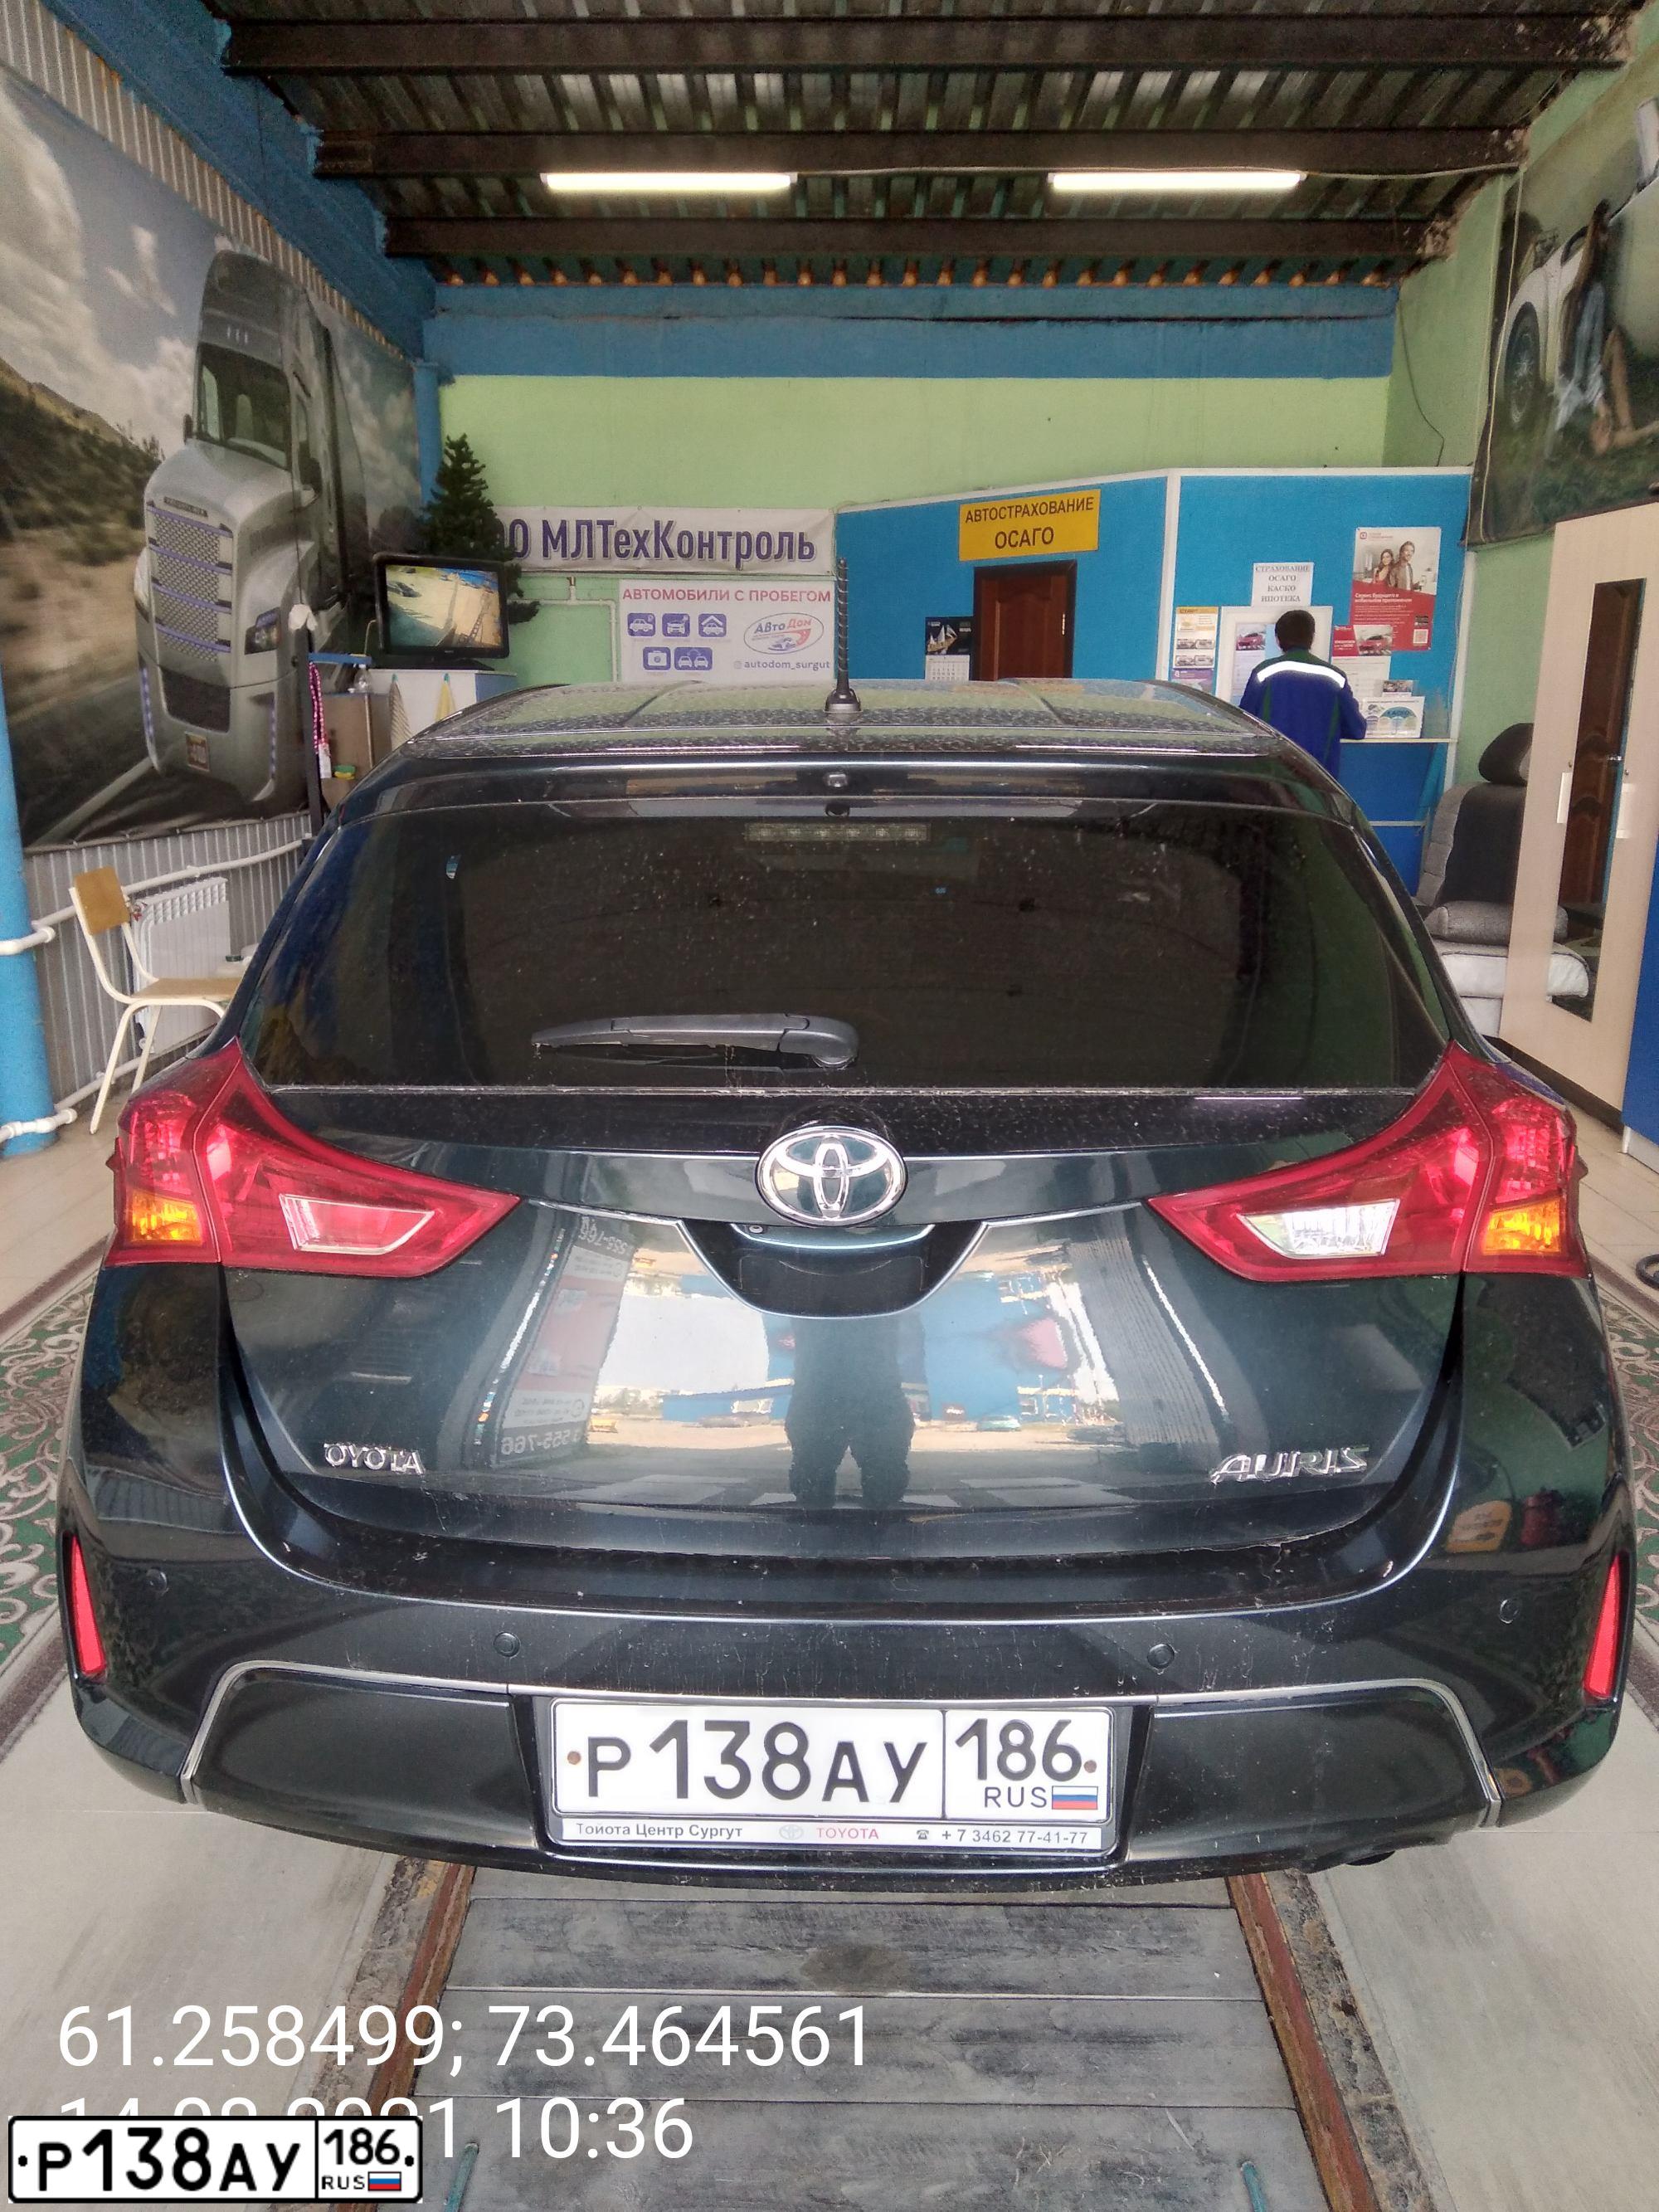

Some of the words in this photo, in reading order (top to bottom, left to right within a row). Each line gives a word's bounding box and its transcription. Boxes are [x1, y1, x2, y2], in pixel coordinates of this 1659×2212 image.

[965, 497, 1095, 524] АВТОСТРАХОВАНИЕ
[542, 519, 816, 571] МЛТехКонтроль
[995, 526, 1054, 549] ОСАГО
[622, 588, 730, 602] АВТОМОБИЛИ
[734, 590, 744, 602] С
[749, 590, 831, 602] ПРОБЕГОМ
[1211, 1446, 1369, 1484] AURIS
[587, 1718, 928, 1804] Р138АУ
[955, 1717, 1082, 1782] 186
[984, 1786, 1048, 1809] RUS
[577, 1822, 630, 1835] Тойота
[636, 1824, 684, 1838] Центр
[688, 1825, 743, 1839] Сургут
[816, 1828, 879, 1839] TOYOTA
[972, 1830, 1011, 1843] 3462
[1017, 1830, 1088, 1844] 77-41-77
